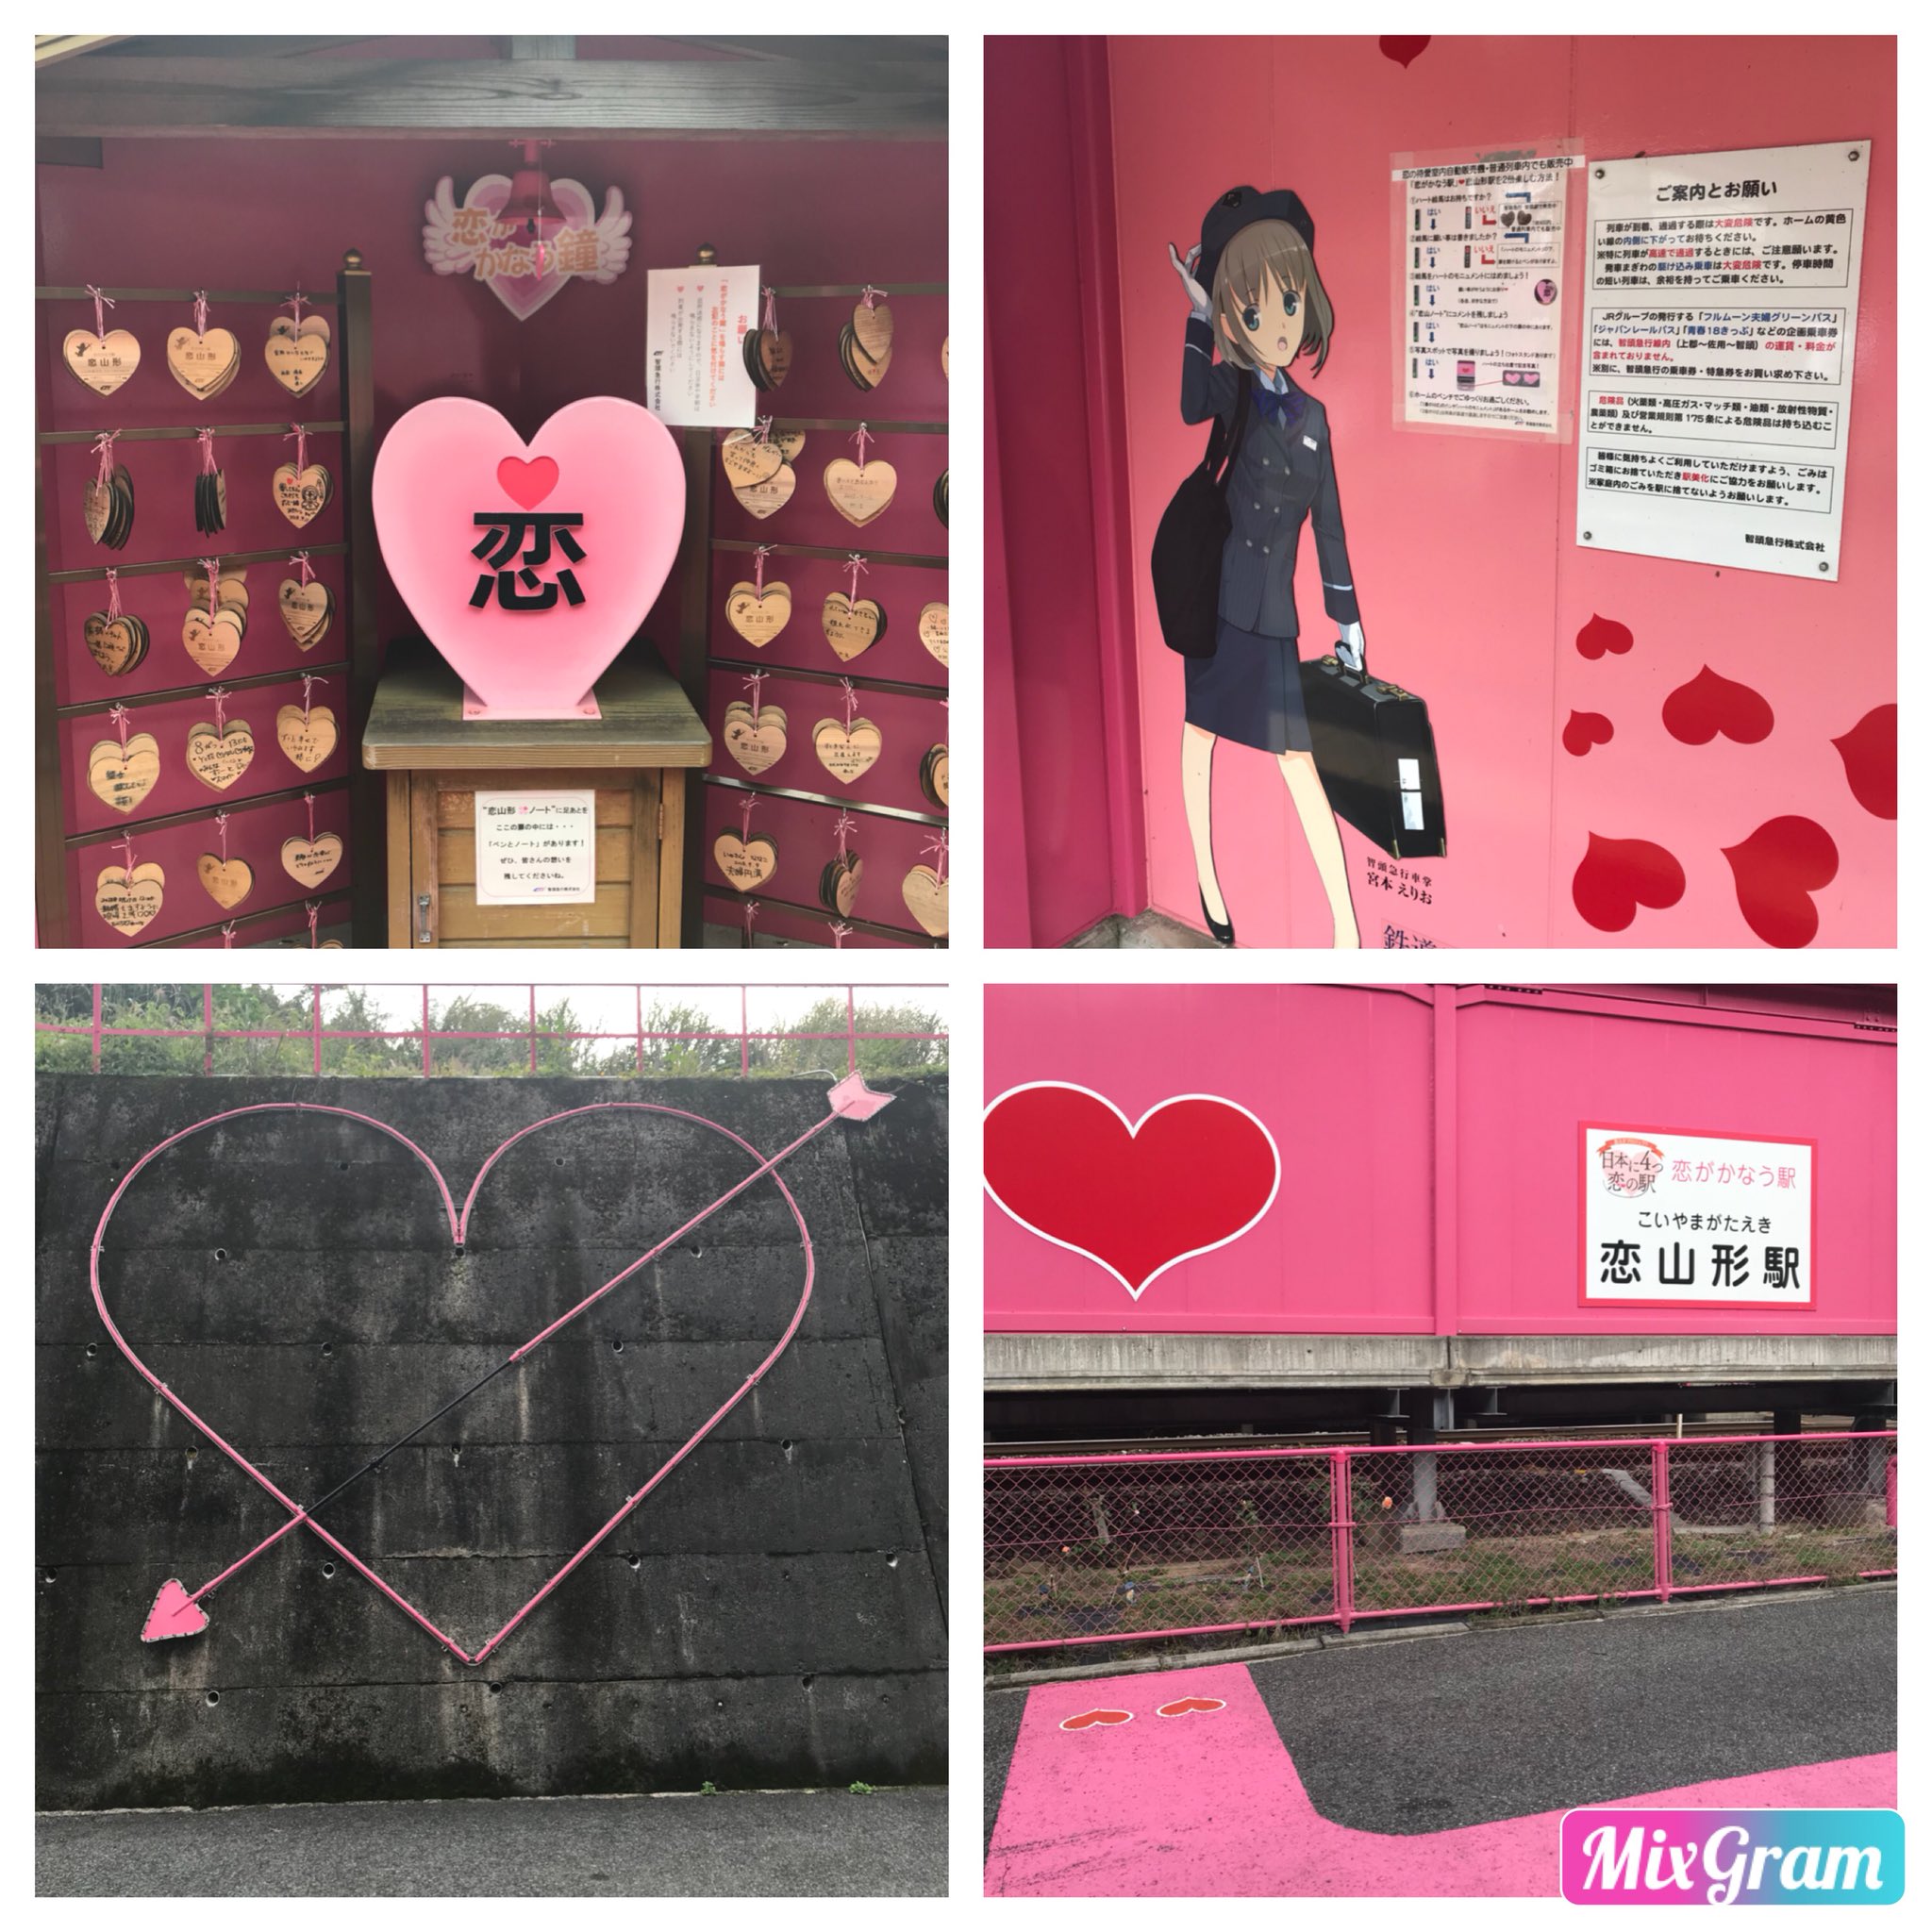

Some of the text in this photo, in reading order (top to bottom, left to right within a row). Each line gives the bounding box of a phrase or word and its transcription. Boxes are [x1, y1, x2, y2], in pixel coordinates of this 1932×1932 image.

[1656, 179, 1777, 202] ご案内とお願い
[1426, 208, 1441, 216] はい
[1607, 213, 1847, 233] 列車が到着、通過する際は大変危険です。ホームの黄色
[1597, 232, 1757, 246] い線の内側に下がってお待ちください。
[1474, 245, 1495, 254] いいえ
[1605, 258, 1834, 273] 発車まぎわの駆け込み乗車は大変危険です。停車時間
[1596, 272, 1784, 286] の短い列車は、余裕を持ってご乗車ください。
[1425, 322, 1440, 330] はい
[1425, 358, 1440, 367] はい
[1592, 351, 1674, 362] 含まれておりません。
[1591, 422, 1653, 434] とができません。
[1745, 533, 1825, 553] 智頭急行株式会社
[469, 512, 588, 611] 恋
[1367, 871, 1433, 906] 宮本 えりお
[1602, 1150, 1664, 1173] 日本に4つ
[1607, 1172, 1657, 1193] 恋の駅
[1671, 1159, 1796, 1190] 恋がかなう駅
[1638, 1211, 1772, 1234] こいやまがたえき
[1600, 1239, 1801, 1290] 恋山形駅
